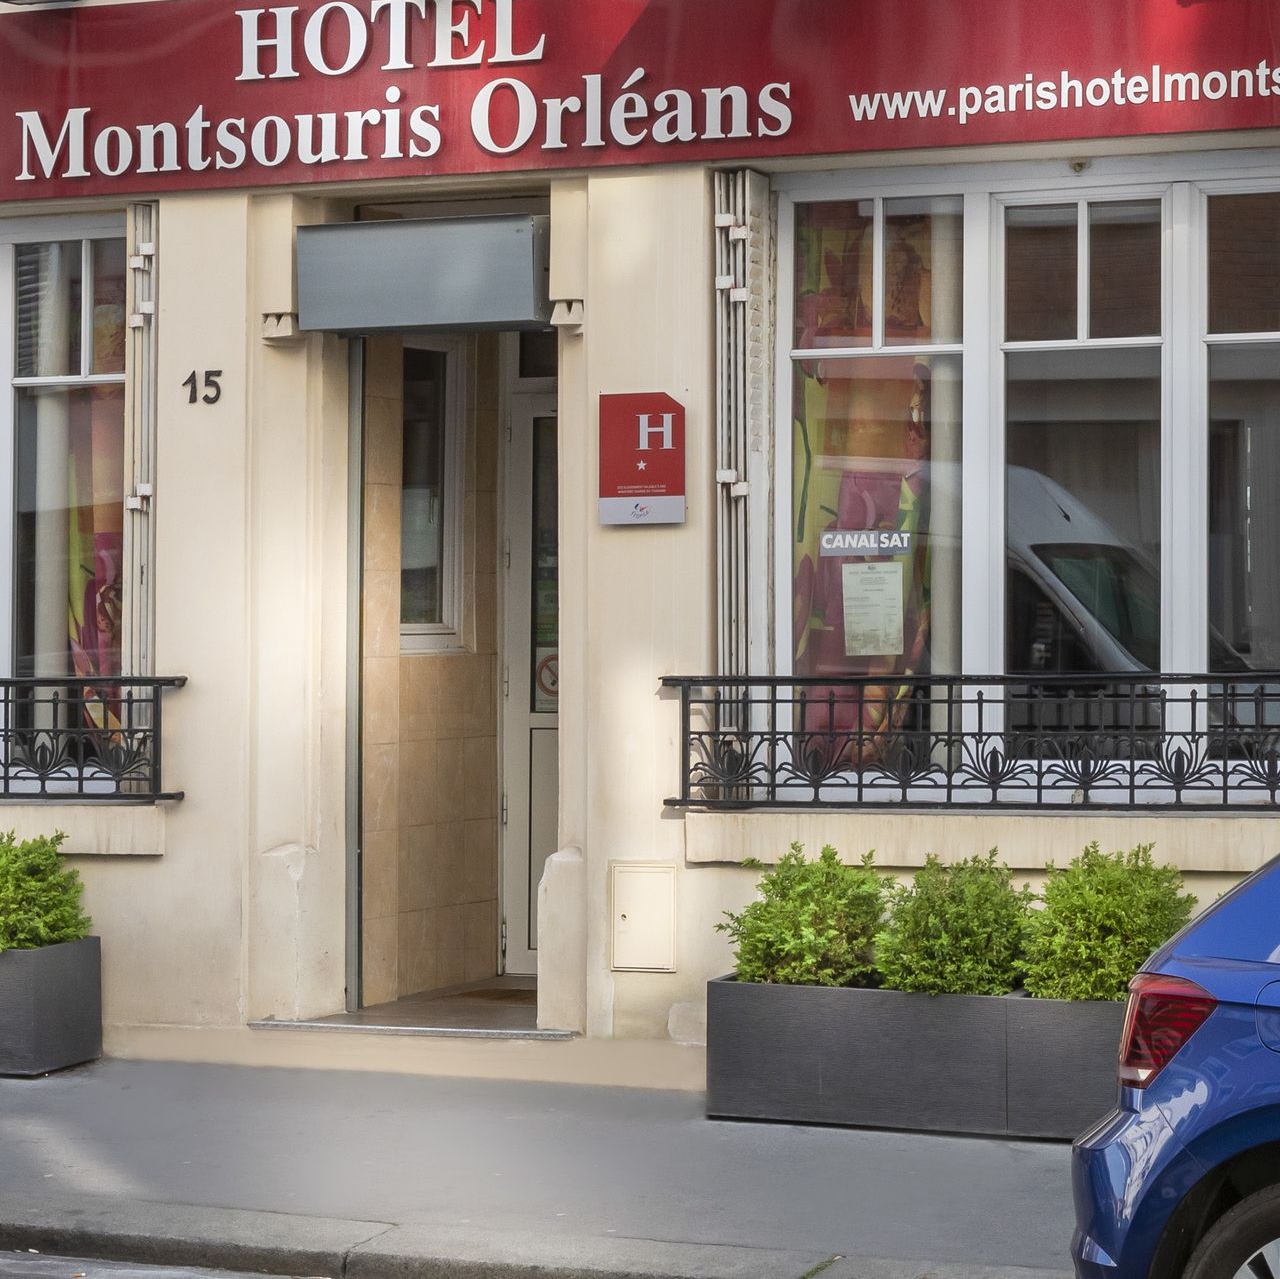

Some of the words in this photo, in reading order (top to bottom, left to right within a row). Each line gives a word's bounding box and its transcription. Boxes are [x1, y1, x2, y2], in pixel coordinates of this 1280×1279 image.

[14, 85, 443, 181] Montsouris
[470, 66, 794, 155] Orléans
[182, 369, 223, 404] 15
[635, 413, 677, 451] H
